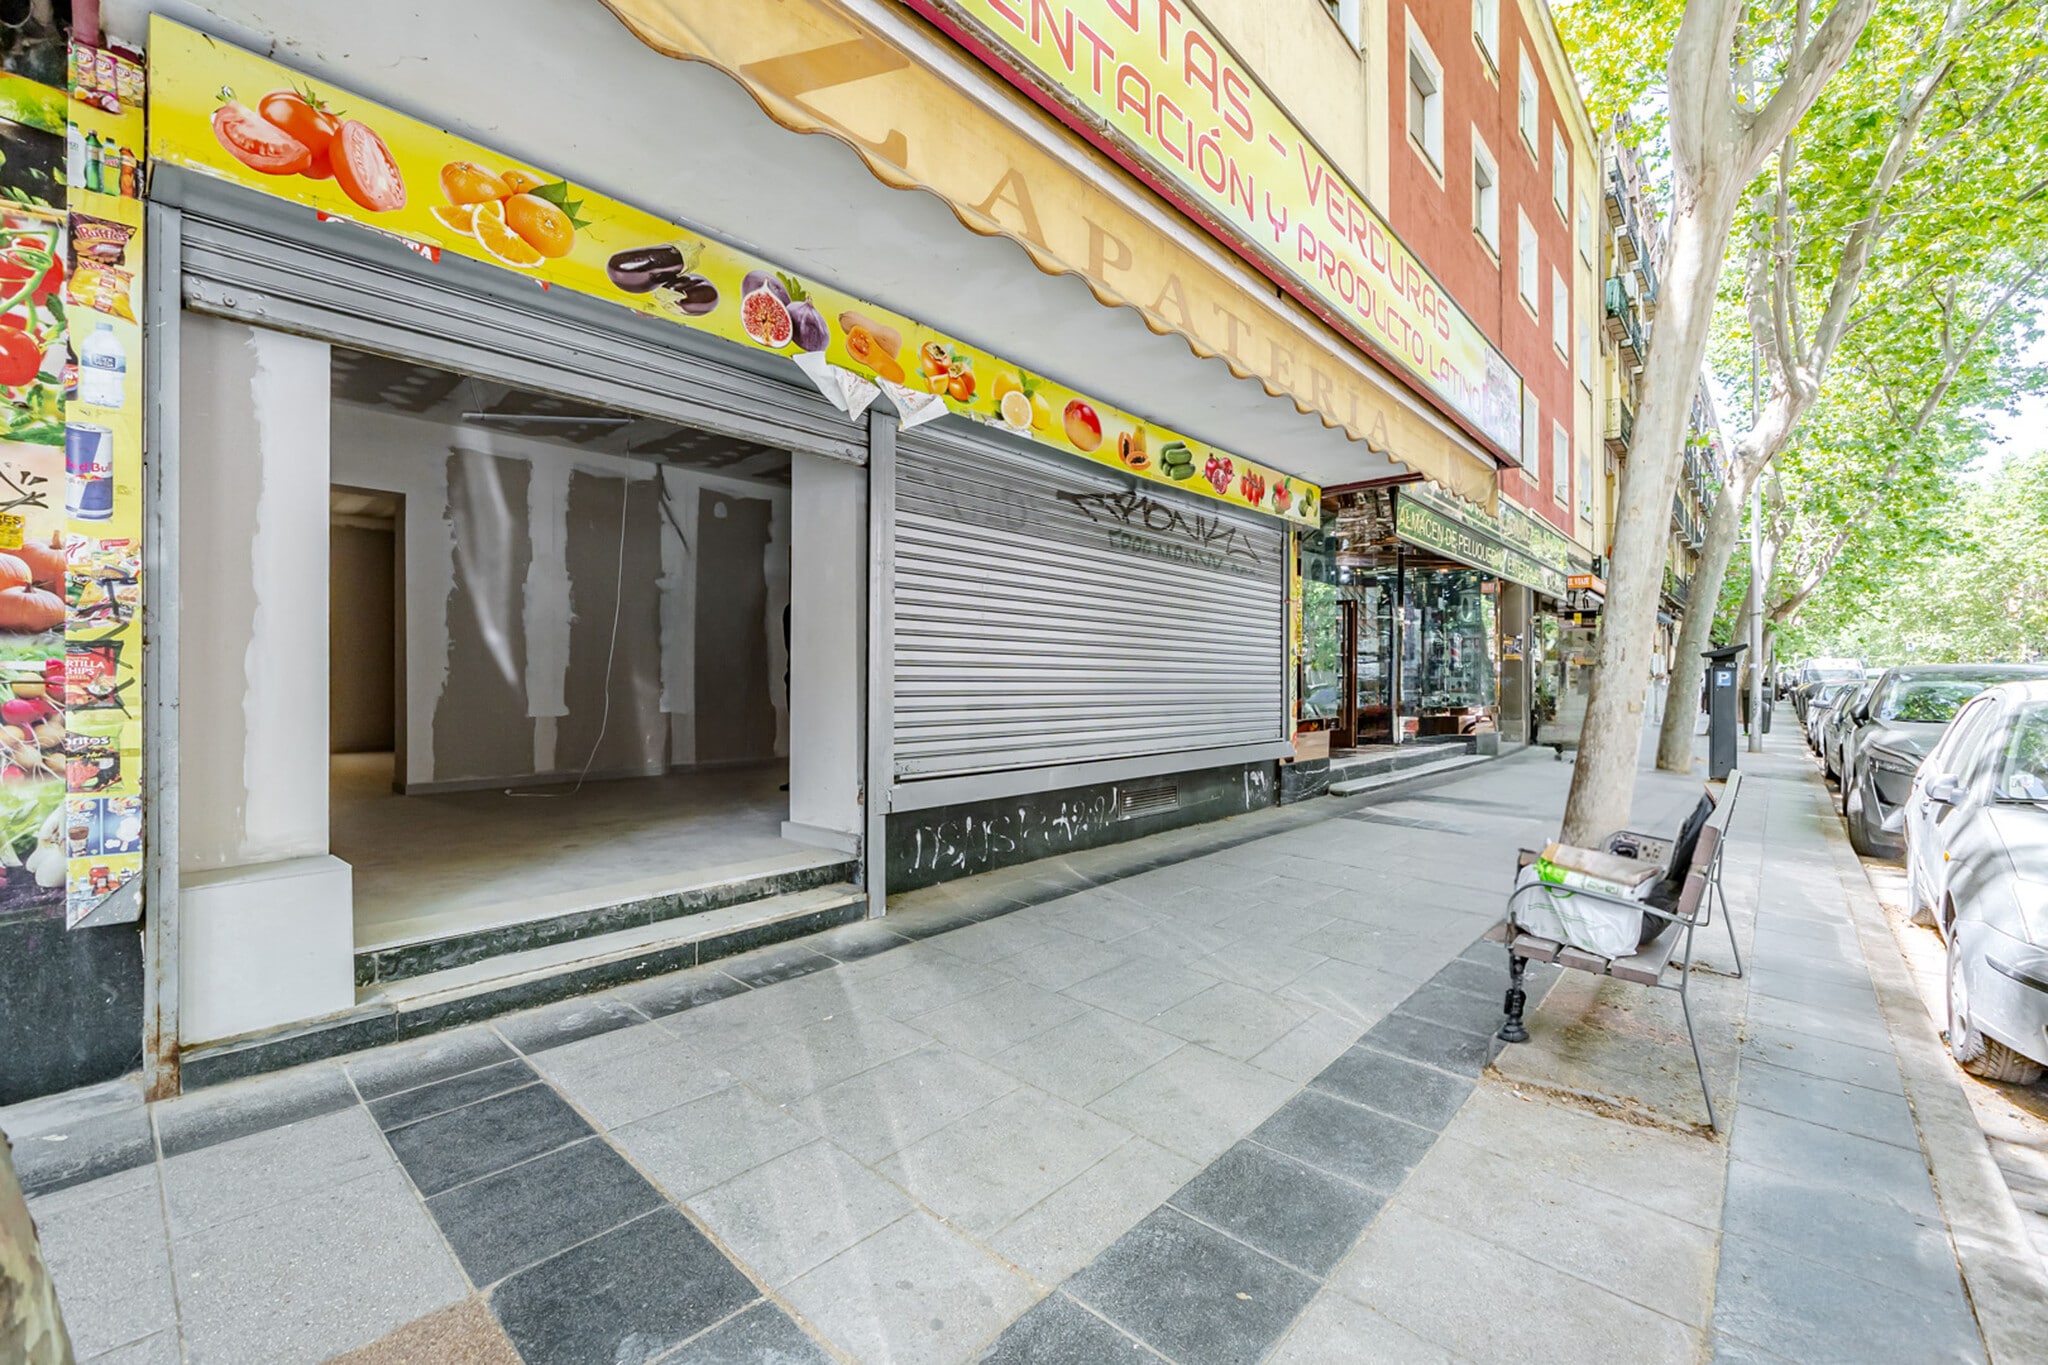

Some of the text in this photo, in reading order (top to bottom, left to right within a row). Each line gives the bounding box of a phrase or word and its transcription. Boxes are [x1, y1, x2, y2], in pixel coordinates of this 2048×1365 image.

[1297, 142, 1451, 342] VERDURAS
[1265, 190, 1289, 243] Y
[1297, 222, 1425, 367] PRODUCTO
[1429, 343, 1482, 416] LATINO
[65, 667, 96, 676] HIPS
[1718, 673, 1729, 683] P
